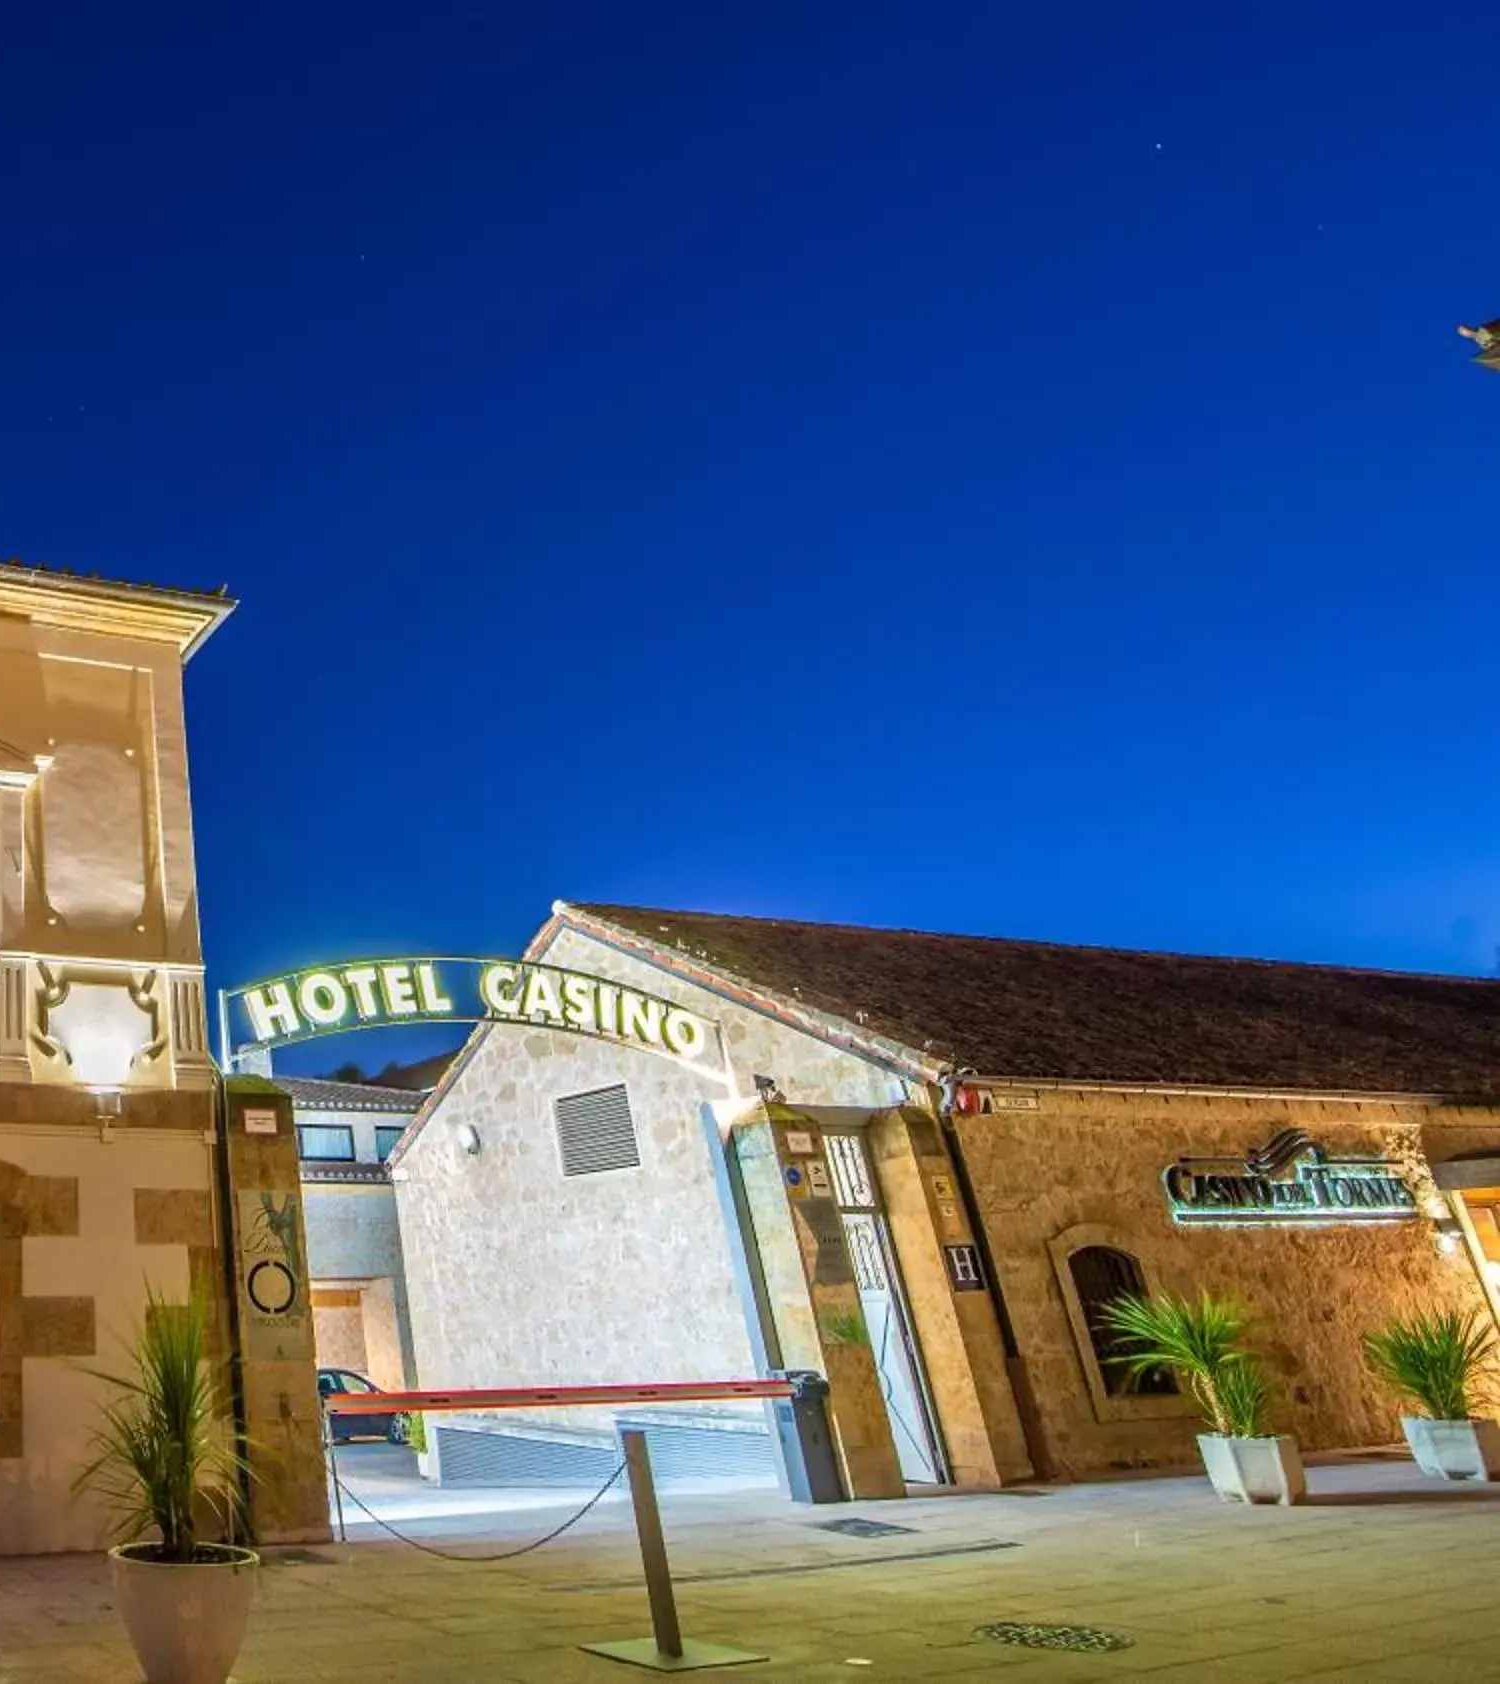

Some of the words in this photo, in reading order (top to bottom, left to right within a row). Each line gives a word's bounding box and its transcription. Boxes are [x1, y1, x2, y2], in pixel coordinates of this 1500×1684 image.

[246, 965, 451, 1041] HOTEL
[481, 964, 706, 1056] CASINO
[948, 1247, 979, 1281] H
